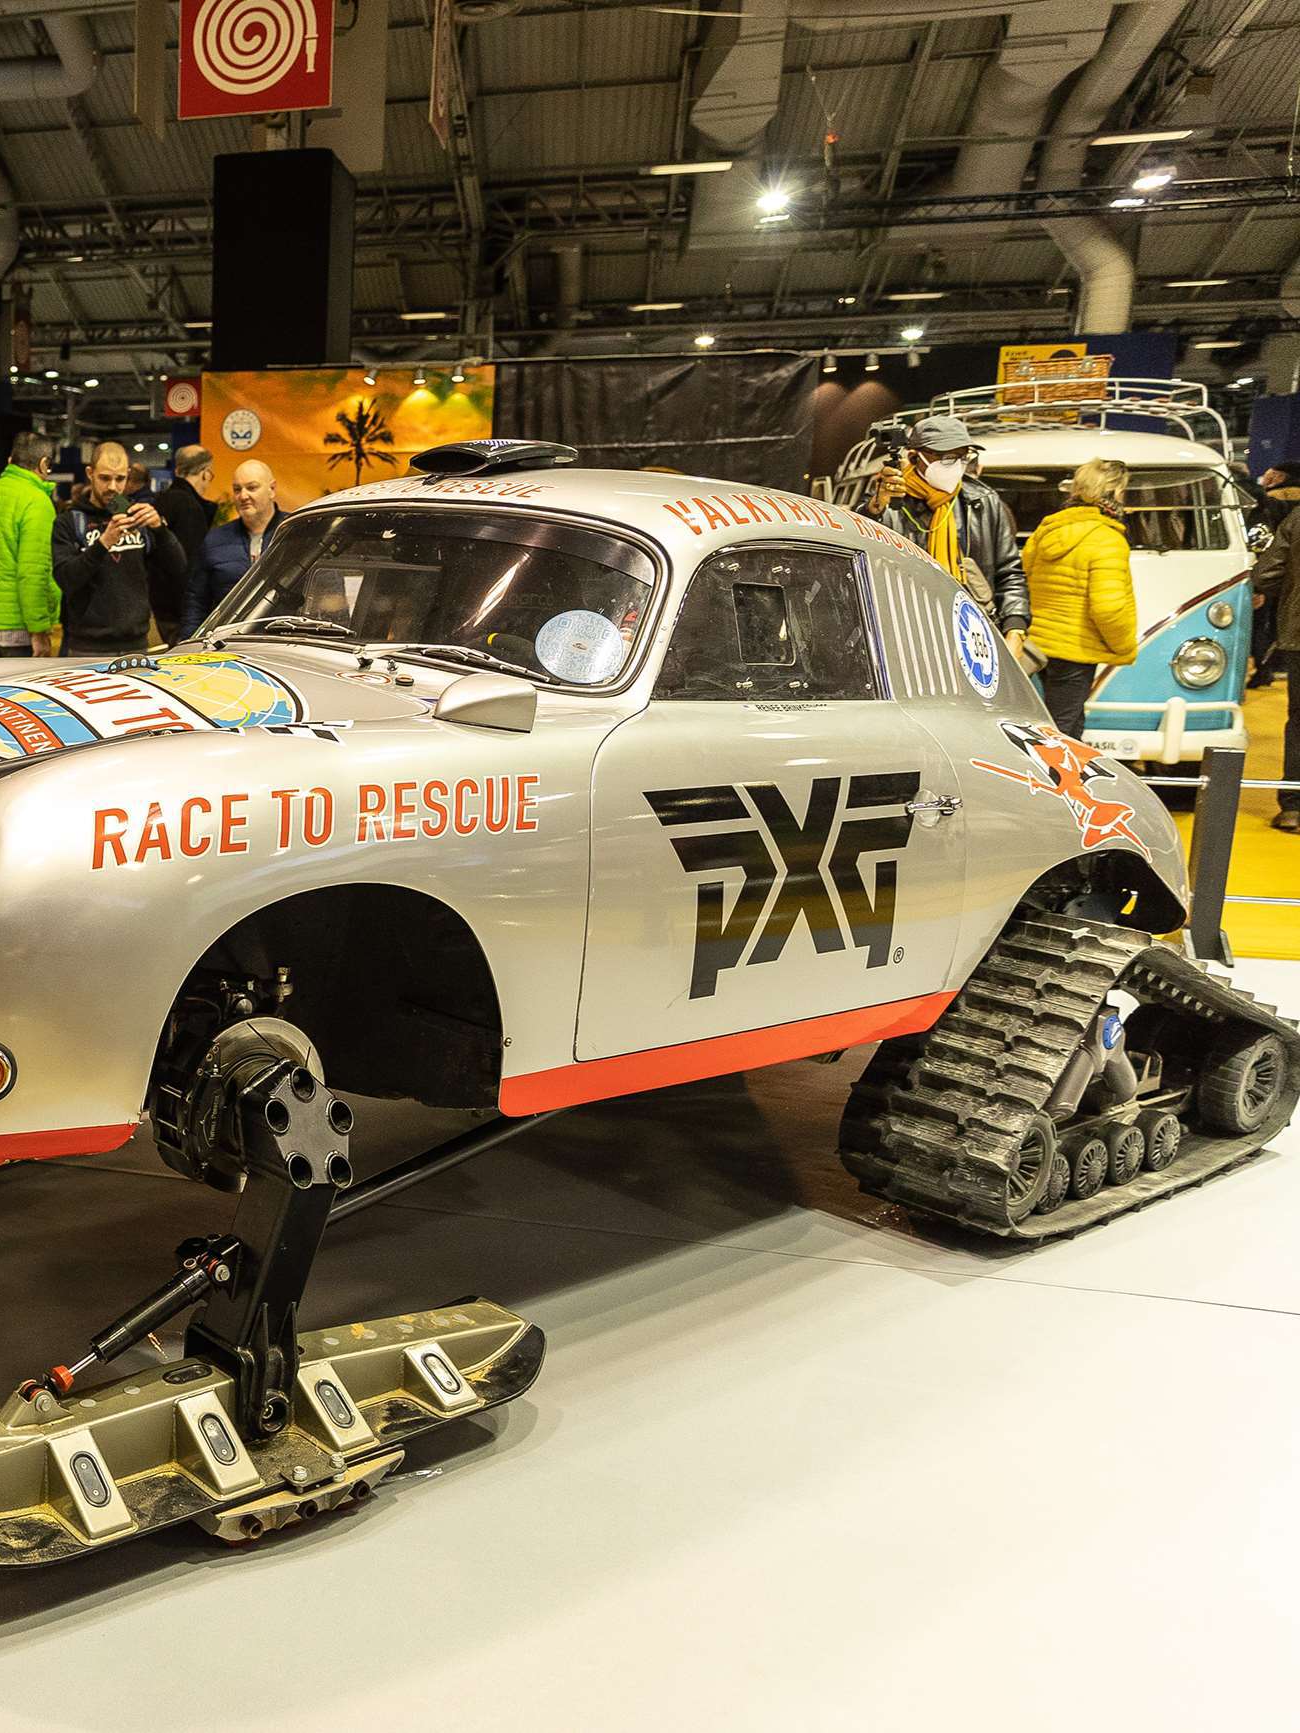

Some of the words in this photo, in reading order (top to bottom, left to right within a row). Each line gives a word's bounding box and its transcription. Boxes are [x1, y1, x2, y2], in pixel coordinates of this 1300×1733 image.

[663, 494, 845, 535] VALKYRIE
[971, 630, 989, 658] 356
[1085, 741, 1117, 751] RASIL
[91, 793, 249, 870] RACE
[271, 786, 335, 849] TO
[357, 774, 540, 843] RESCUE
[642, 771, 920, 1000] PXG
